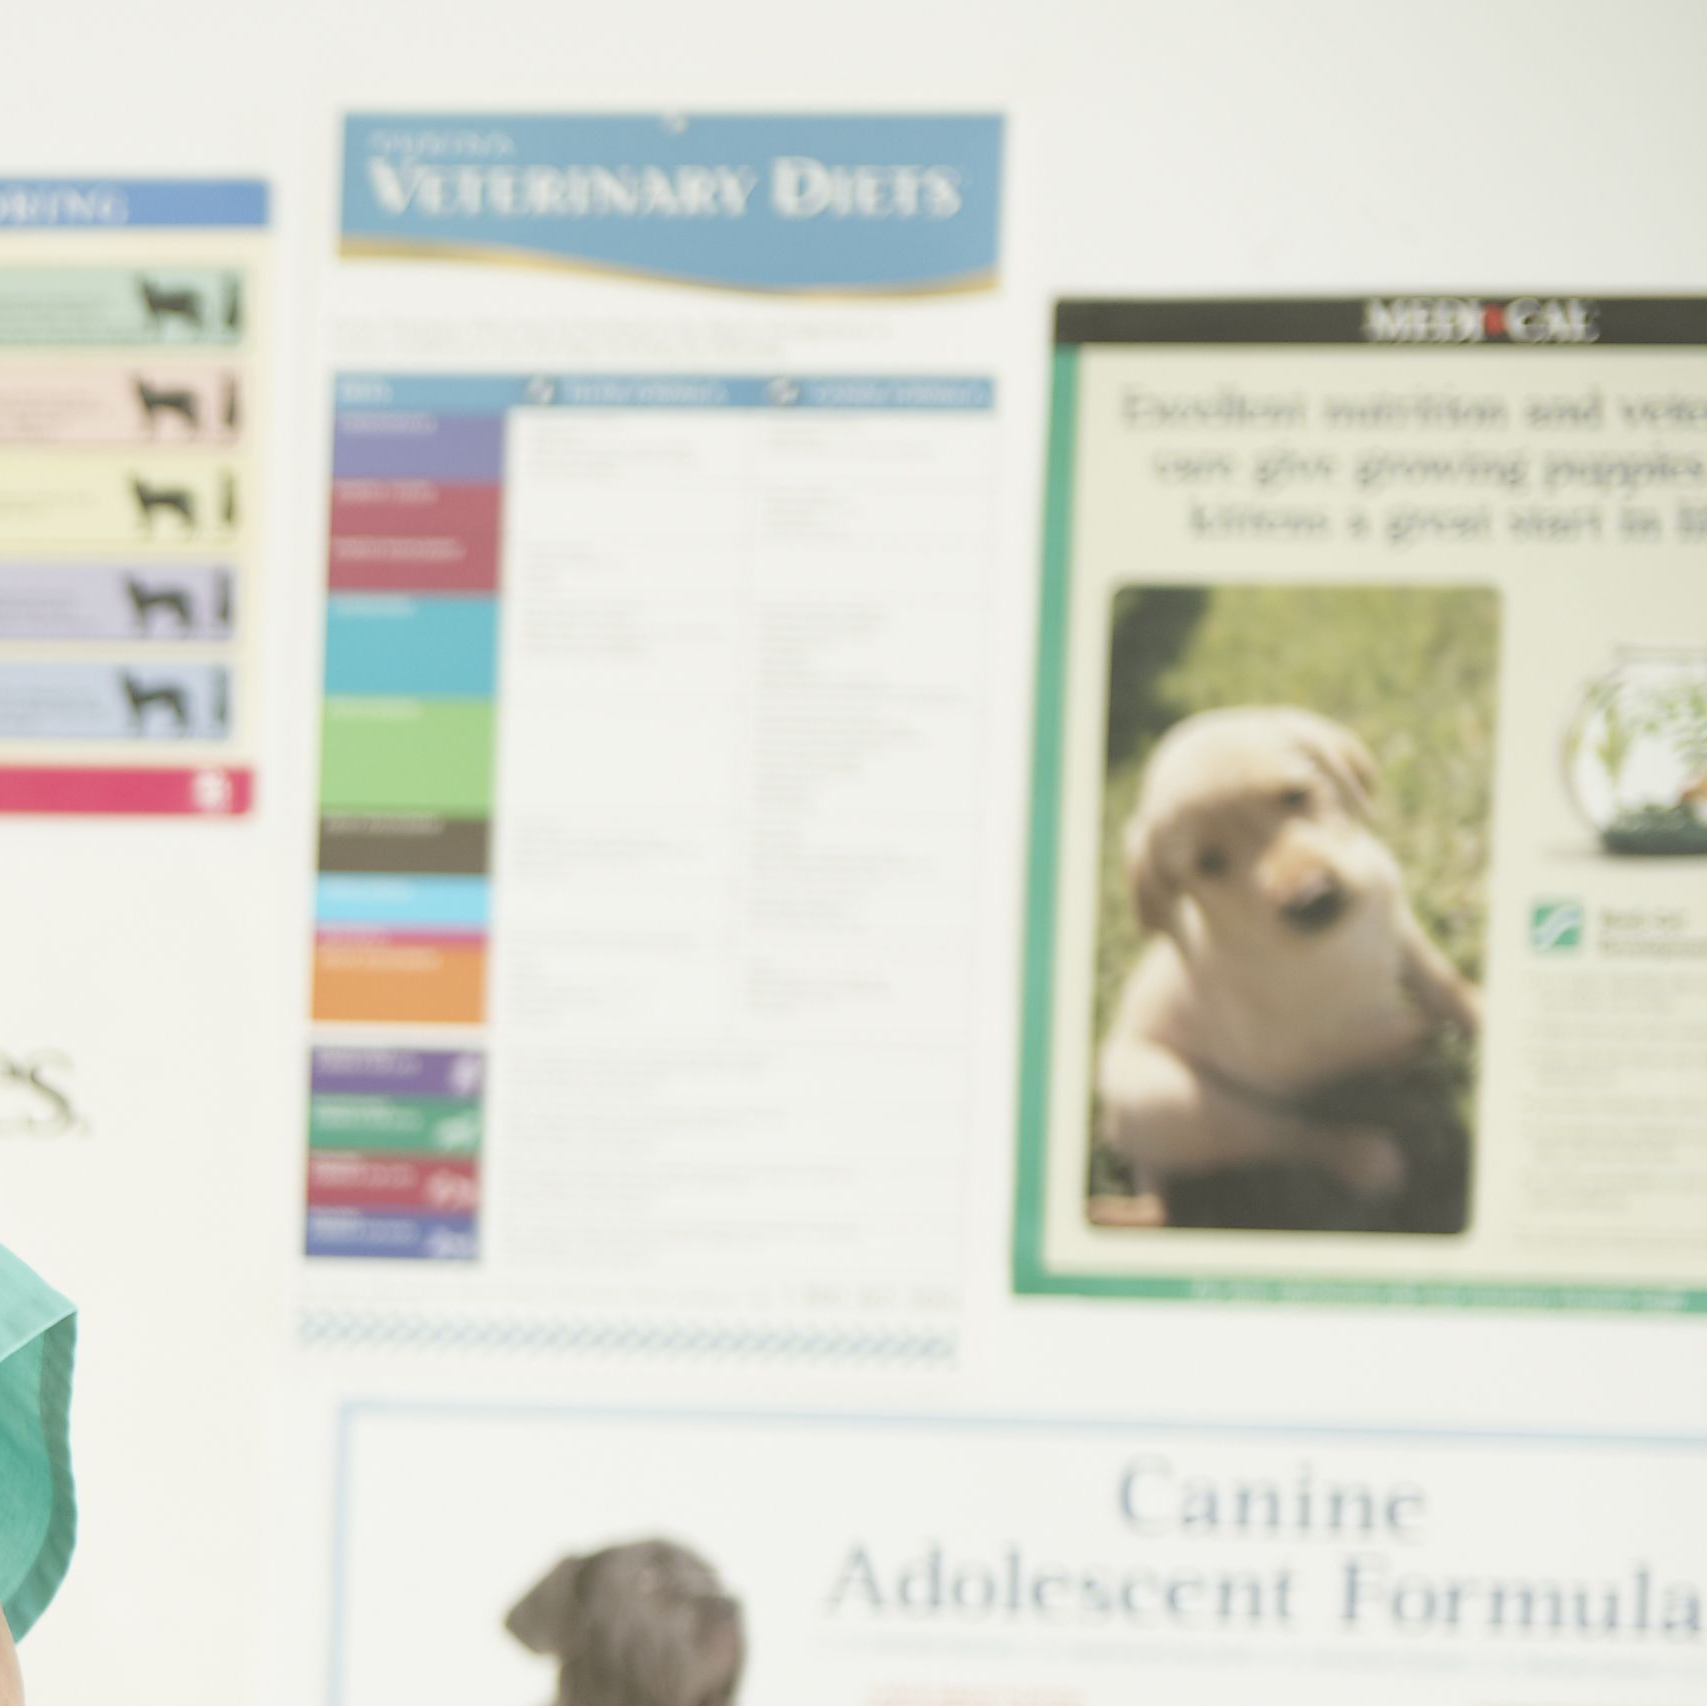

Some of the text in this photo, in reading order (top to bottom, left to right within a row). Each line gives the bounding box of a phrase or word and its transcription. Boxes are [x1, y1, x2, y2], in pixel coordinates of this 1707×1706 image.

[367, 155, 963, 219] VETERINARY DIETS
[1117, 1452, 1427, 1542] Canine
[823, 1540, 1706, 1642] Adolescent Formula
